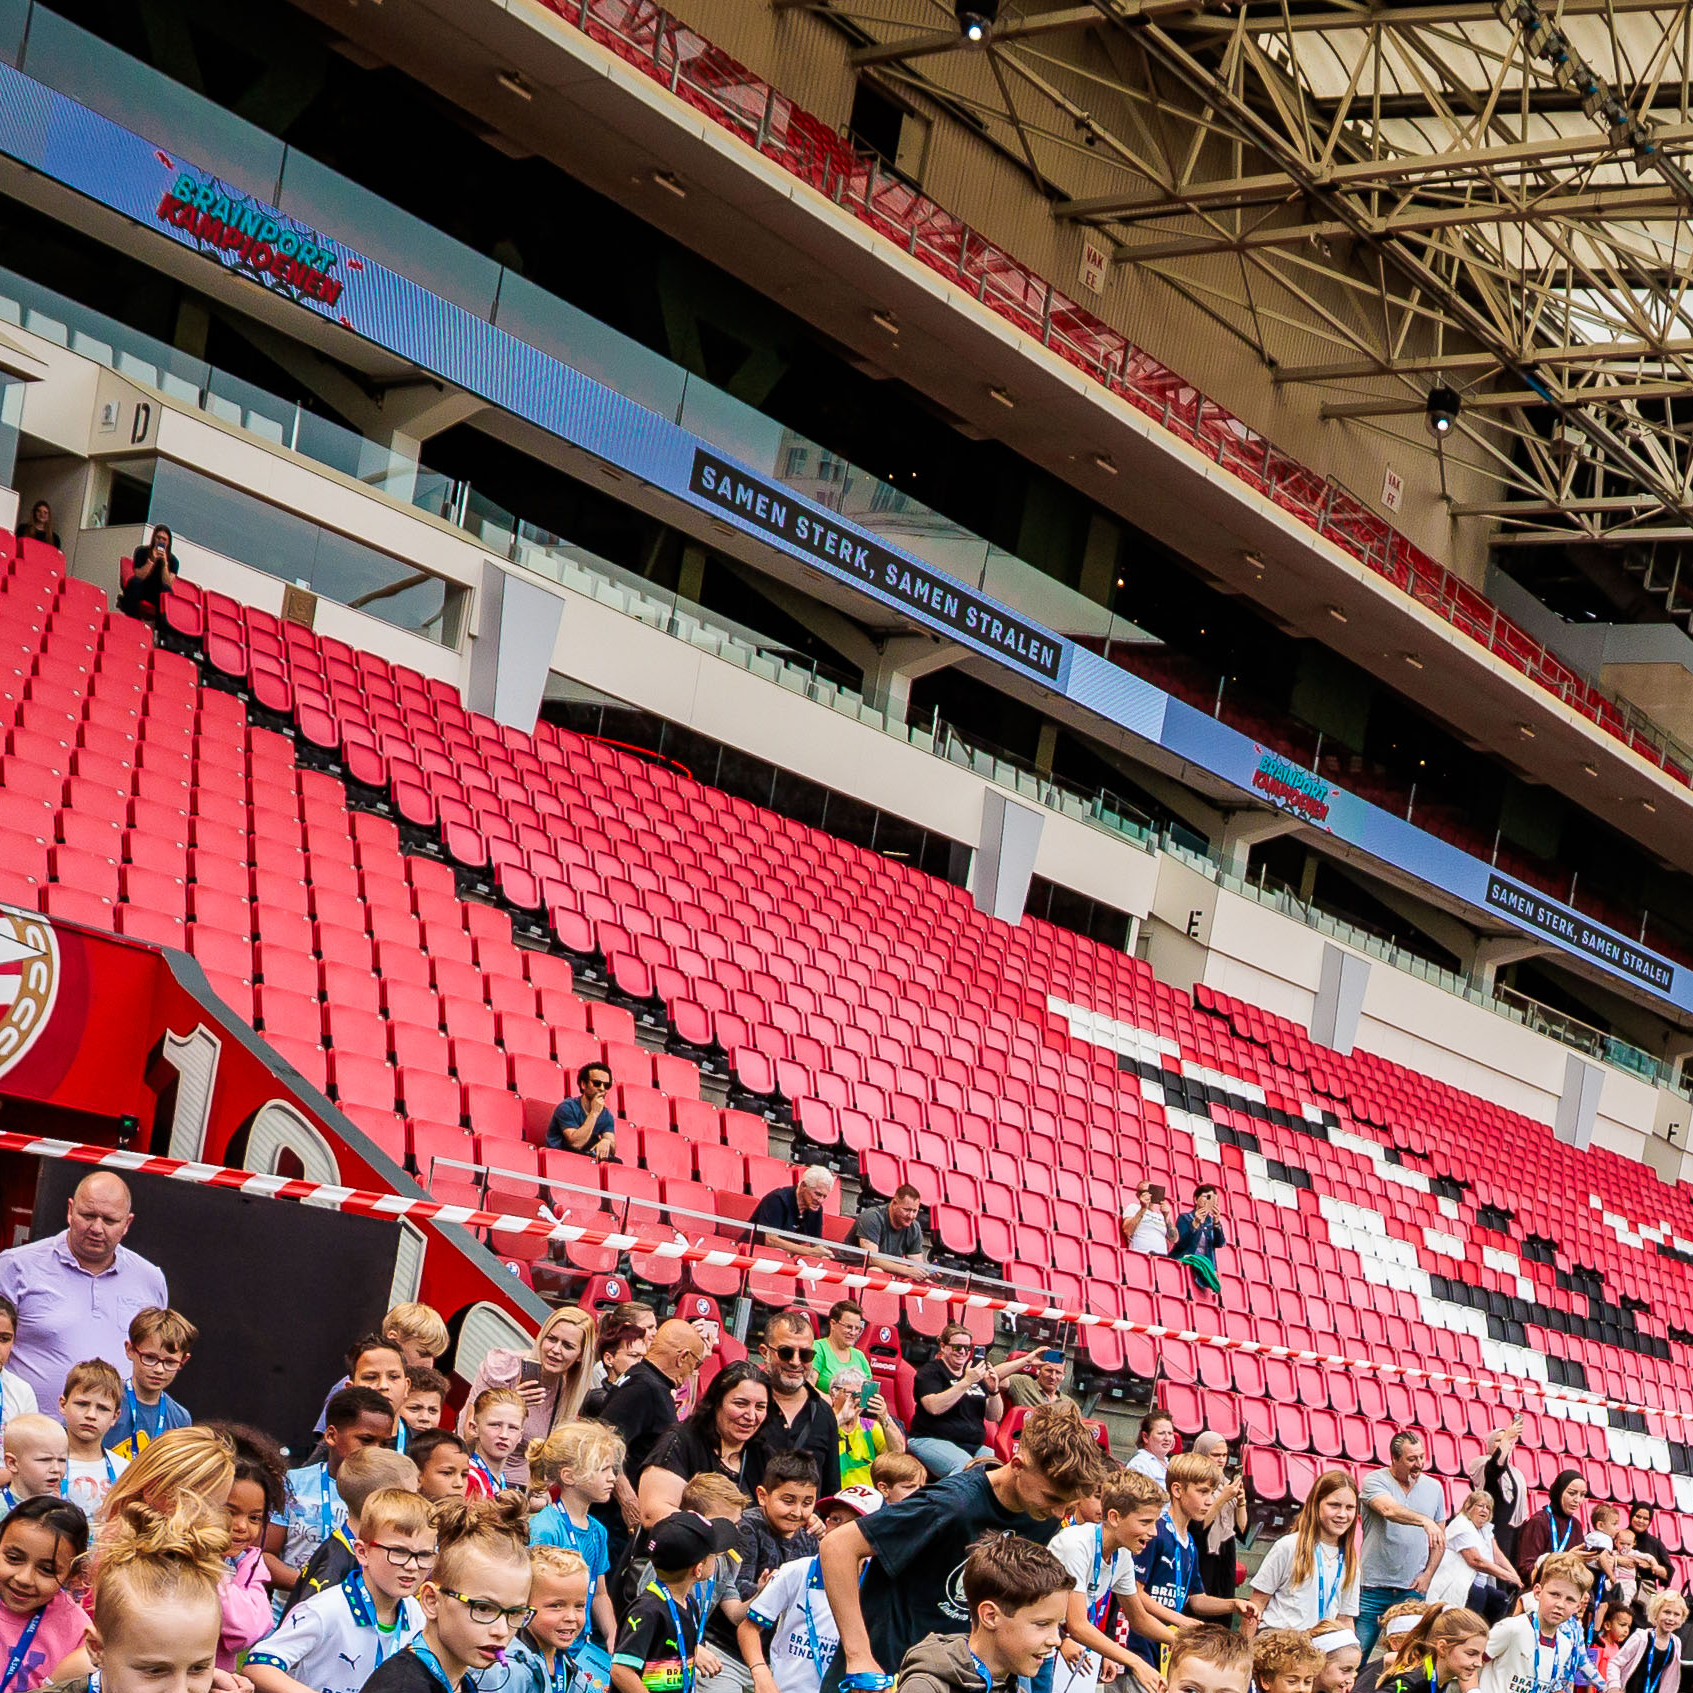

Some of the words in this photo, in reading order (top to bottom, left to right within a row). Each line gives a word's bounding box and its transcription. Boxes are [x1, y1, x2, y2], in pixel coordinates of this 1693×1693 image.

[173, 173, 337, 273] BRAINPORT
[156, 192, 344, 307] KAMPIOENEN
[1087, 246, 1104, 271] VAK
[131, 402, 150, 444] D
[701, 466, 786, 527] SAMEN
[796, 515, 875, 578] STERK,
[885, 563, 959, 617] SAMEN
[966, 606, 1056, 668] STRALEN
[1259, 755, 1328, 802] BRAINPORT
[1187, 910, 1202, 937] E
[1492, 884, 1534, 917] SAMEN
[1537, 908, 1577, 943] STERK,
[1581, 930, 1620, 961] SAMEN
[1622, 951, 1671, 986] STRALEN
[1667, 1123, 1679, 1143] F
[7, 1656, 21, 1675] ASML
